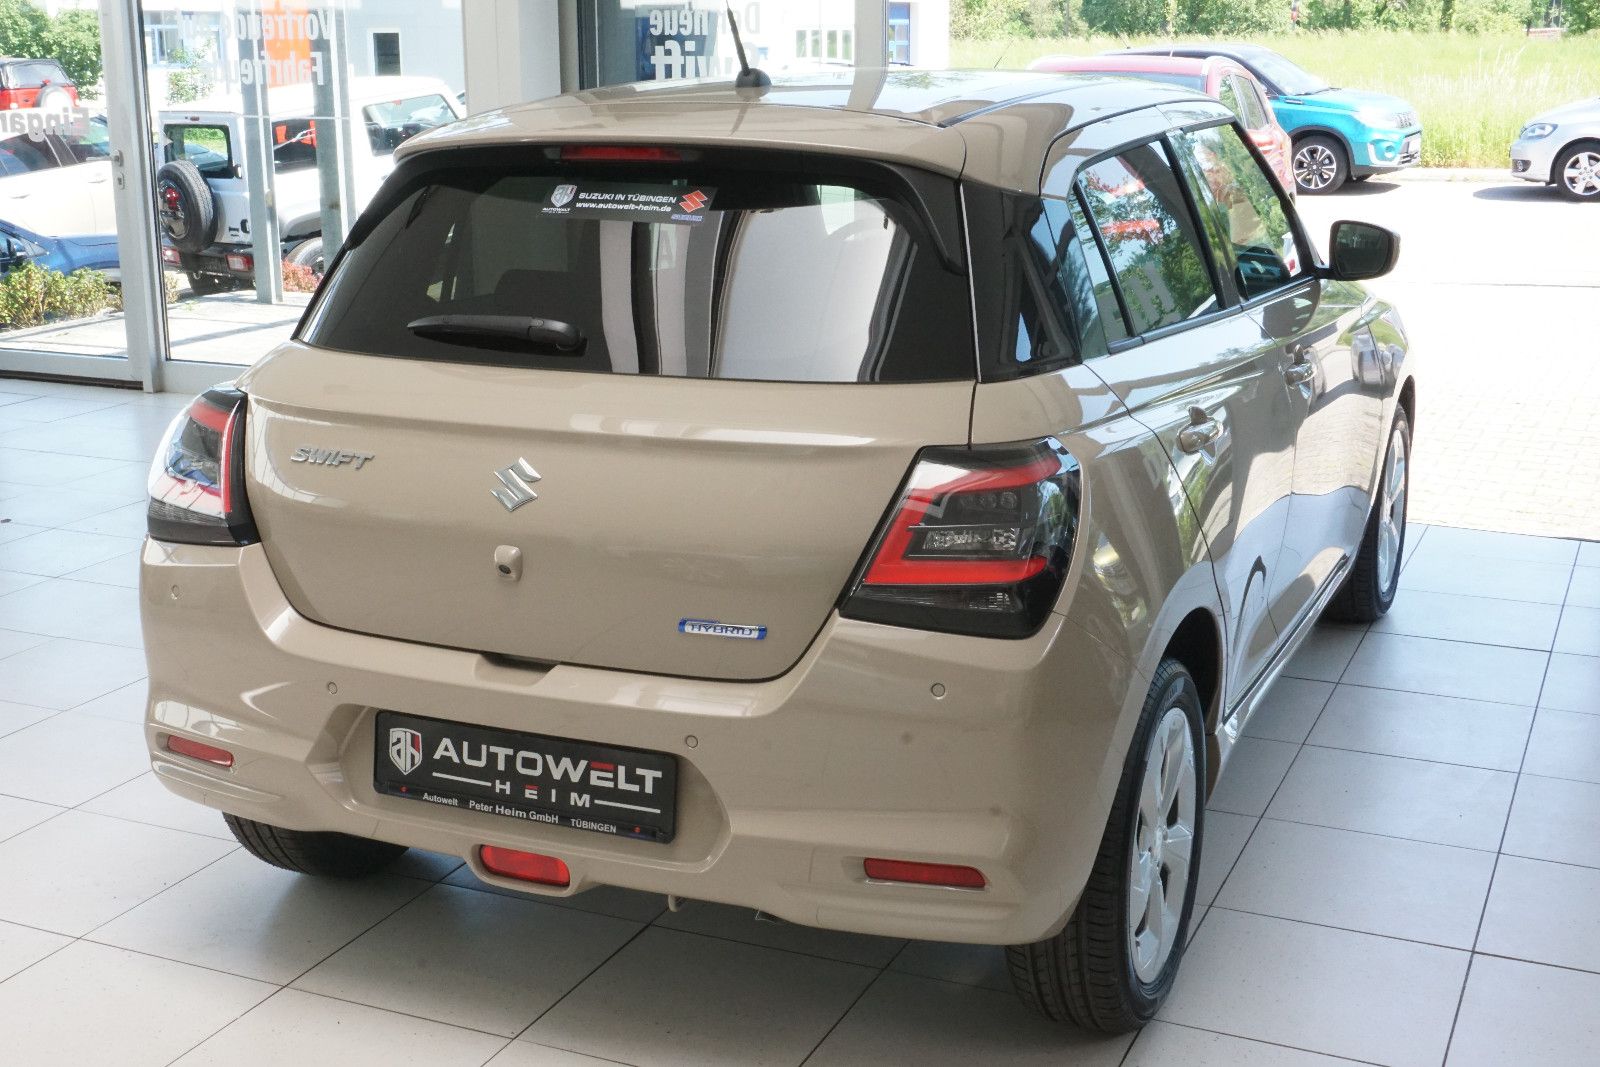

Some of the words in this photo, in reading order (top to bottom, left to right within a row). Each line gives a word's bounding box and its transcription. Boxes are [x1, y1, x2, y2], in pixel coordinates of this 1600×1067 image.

[578, 192, 614, 201] SUZUKI
[628, 194, 676, 203] TÜBINGEN
[290, 447, 376, 471] SWIFT
[690, 623, 754, 637] HYBRID
[433, 737, 662, 794] AUTOWELT
[422, 791, 459, 807] Autowelt
[495, 779, 590, 808] HEIM
[469, 800, 493, 813] Peter
[495, 804, 527, 819] Heim
[528, 810, 559, 824] GmbH
[570, 818, 617, 833] TÜBINGEN
